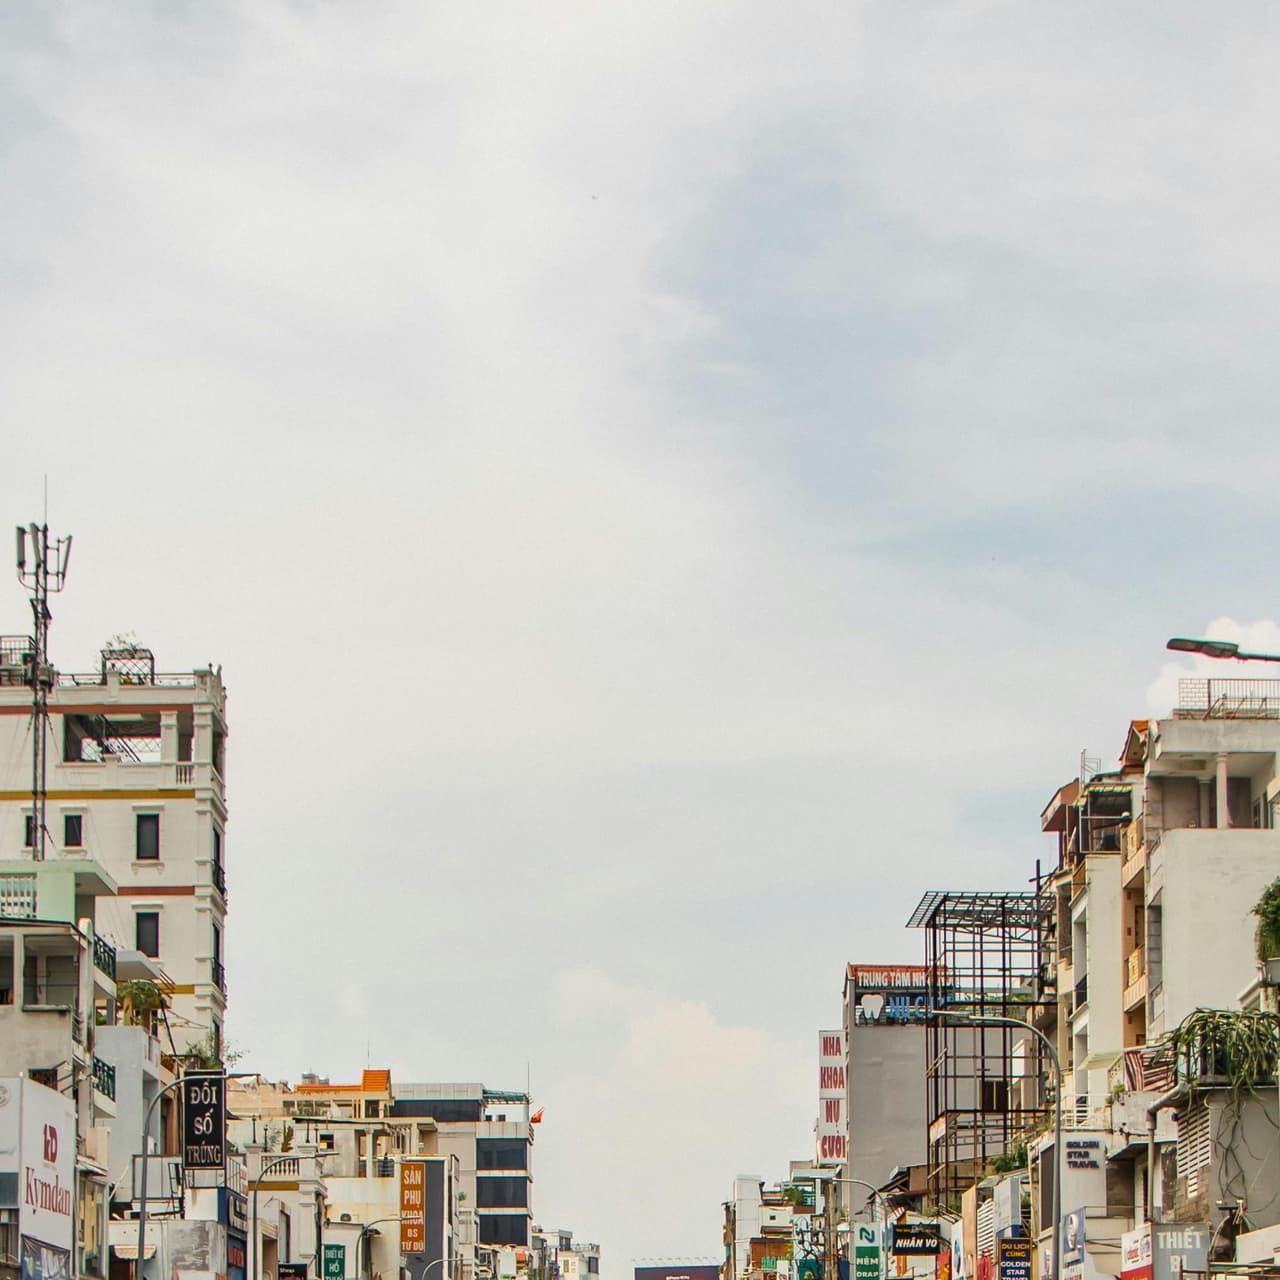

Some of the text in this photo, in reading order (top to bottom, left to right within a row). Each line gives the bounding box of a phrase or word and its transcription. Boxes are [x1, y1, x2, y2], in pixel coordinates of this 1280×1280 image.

[858, 972, 889, 988] TRUNG
[890, 968, 909, 988] TÂM
[822, 1036, 842, 1057] NHA
[820, 1066, 845, 1089] KHOA
[193, 1107, 213, 1135] SỐ
[825, 1100, 840, 1127] NỤ
[186, 1140, 221, 1164] TRÚNG
[1066, 1140, 1100, 1149] GOLDEN
[1067, 1151, 1090, 1160] STAR
[1068, 1160, 1100, 1169] TRAVEL
[403, 1190, 422, 1209] PHỤ
[1157, 1226, 1203, 1250] THIẾT
